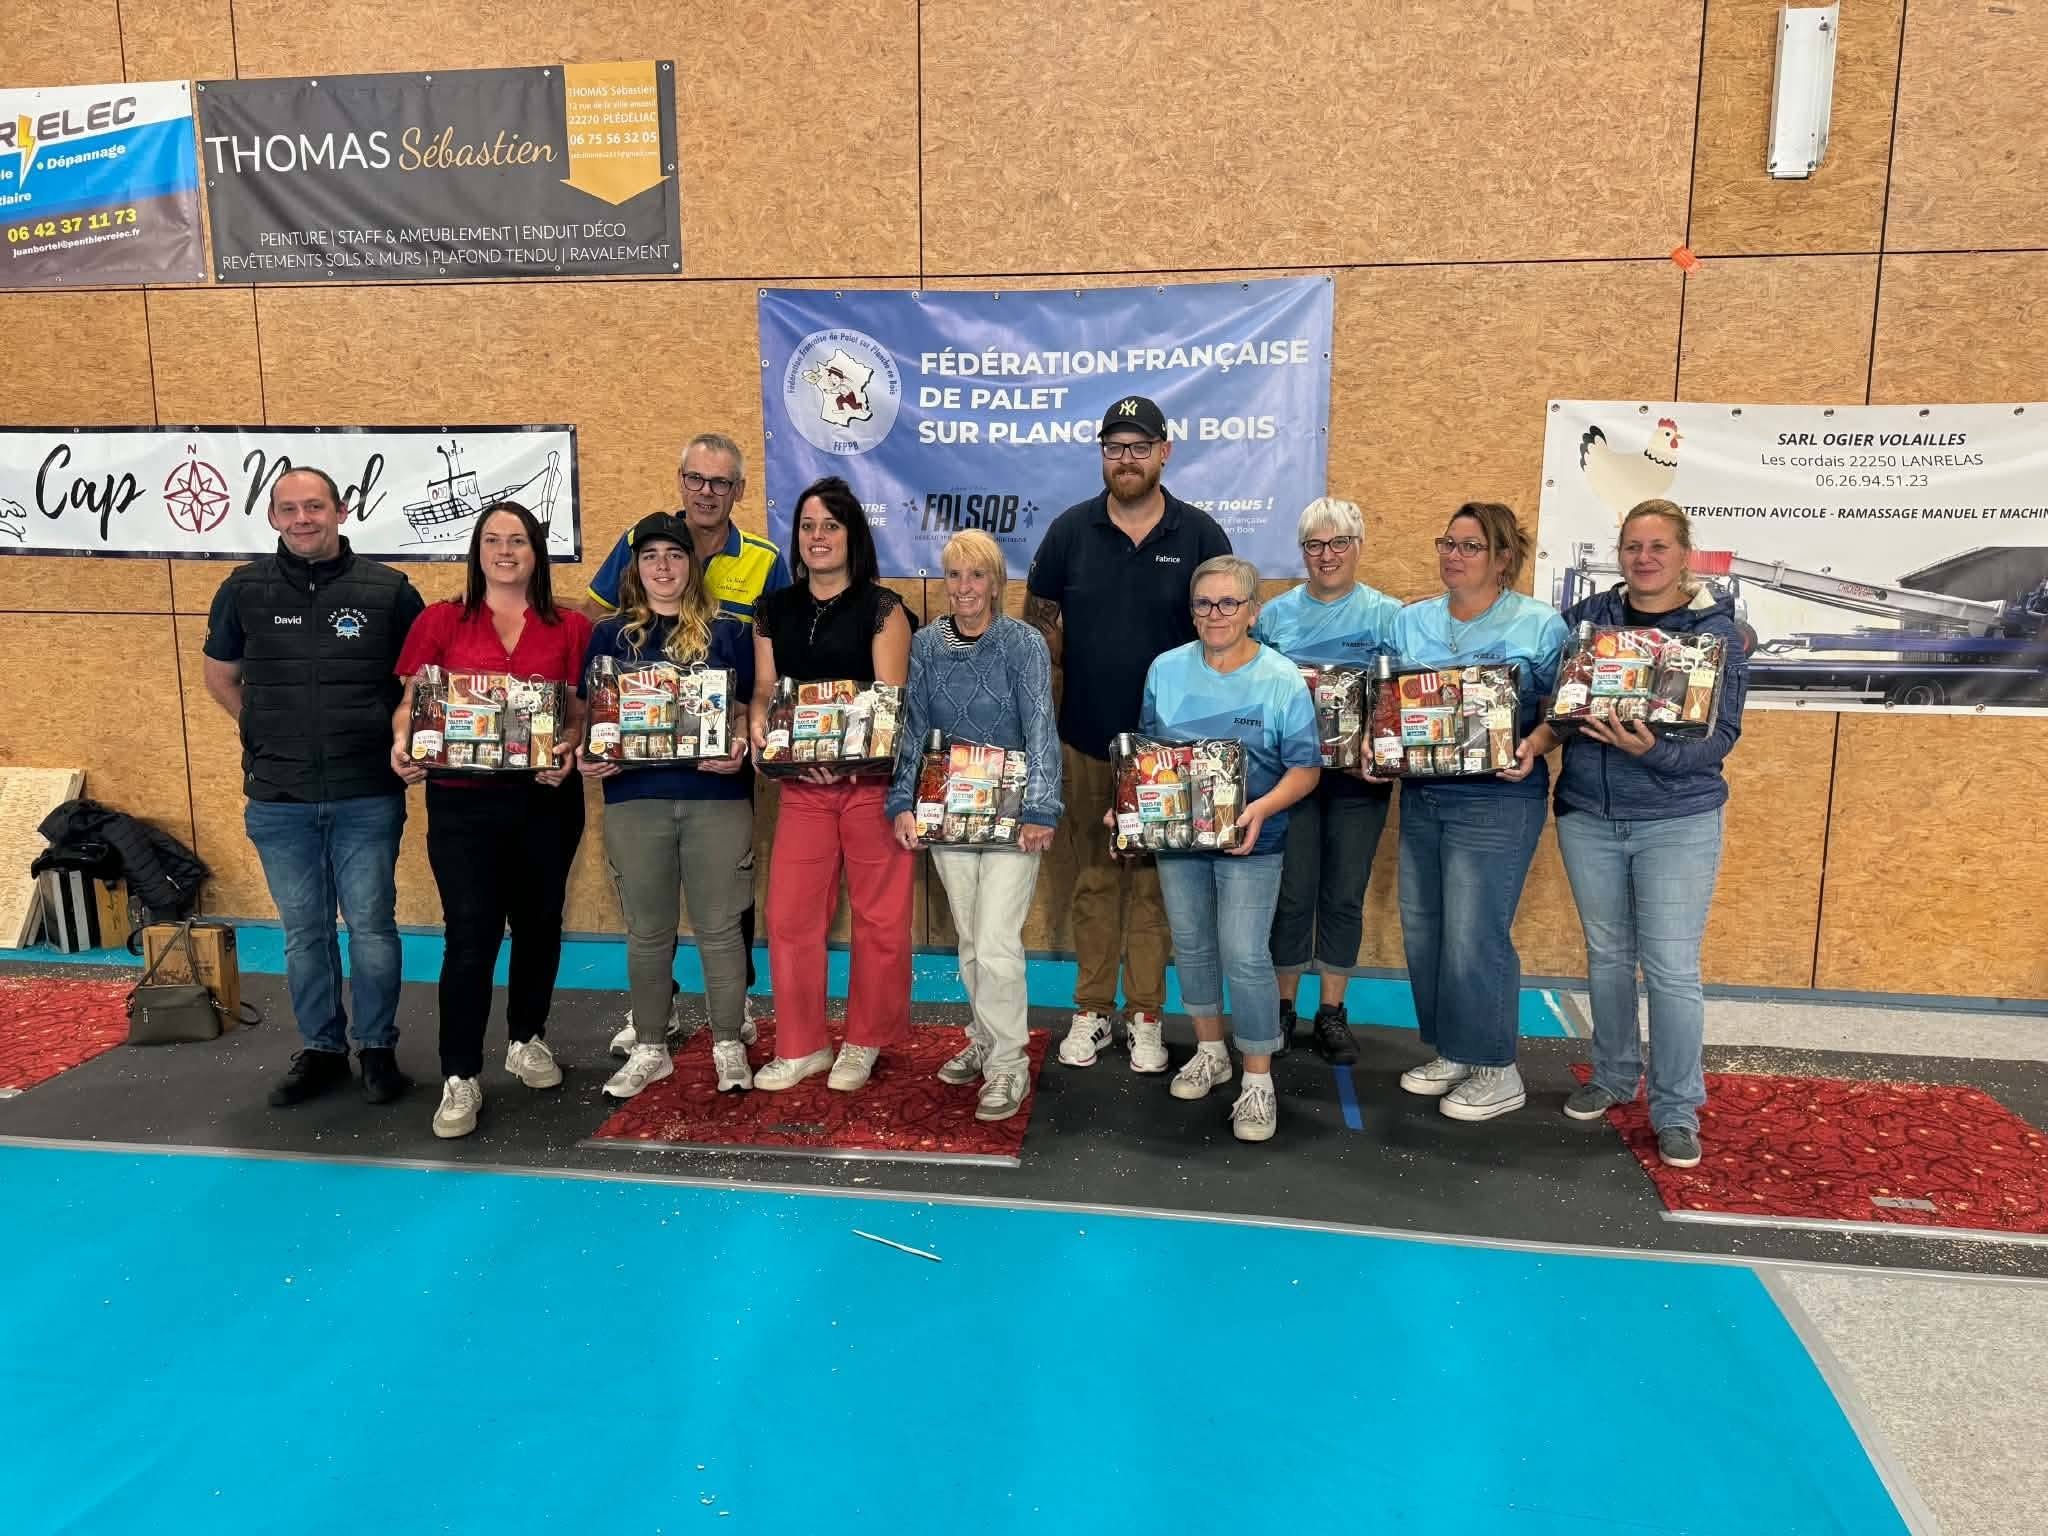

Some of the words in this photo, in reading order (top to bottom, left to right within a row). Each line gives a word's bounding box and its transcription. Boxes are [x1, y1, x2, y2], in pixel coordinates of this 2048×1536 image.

[205, 131, 391, 173] THOMAS
[399, 126, 558, 170] Sébastien
[570, 134, 585, 144] 06
[588, 133, 602, 144] 75
[606, 133, 621, 144] 56
[624, 132, 639, 143] 32
[642, 131, 657, 143] 05
[47, 142, 127, 170] Dépannage
[8, 227, 30, 242] 06
[34, 222, 57, 237] 42
[60, 218, 82, 234] 37
[89, 213, 111, 229] 11
[115, 208, 137, 223] 73
[260, 230, 328, 246] PEINTURE
[338, 229, 384, 245] STAFF
[386, 229, 396, 244] &
[400, 225, 512, 243] AMEUBLEMENT
[523, 222, 579, 240] ENDUIT
[583, 218, 626, 239] DÉCO
[222, 251, 322, 270] REVÊTEMENTS
[326, 252, 360, 267] SOLS
[364, 252, 375, 267] &
[379, 250, 421, 266] MURS
[433, 247, 504, 265] PLAFOND
[506, 246, 557, 263] TENDU
[570, 244, 671, 262] RAVALEMENT
[920, 346, 1118, 376] FÉDÉRATION
[1127, 340, 1310, 374] FRANÇAISE
[919, 386, 961, 410] DE
[971, 387, 1069, 411] PALET
[918, 420, 979, 446] SUR
[989, 420, 1103, 446] PLANC
[1167, 417, 1189, 441] N
[1199, 416, 1276, 441] BOIS
[1777, 432, 1818, 447] SARL
[1822, 433, 1874, 447] OGIER
[1879, 432, 1967, 447] VOLAILLES
[187, 443, 197, 455] N
[1761, 453, 1786, 466] Les
[1790, 453, 1845, 468] cordais
[1849, 455, 1897, 468] 22250
[1901, 453, 1985, 468] LANRELAS
[35, 443, 147, 541] Cap
[243, 449, 387, 522] Nd
[1815, 474, 1929, 488] 06.26.94.51.23
[921, 493, 1020, 534] FALSAB
[1217, 499, 1263, 511] nous
[1680, 506, 1766, 518] TERVENTION
[1770, 507, 1827, 519] AVICOLE
[1838, 507, 1919, 519] RAMASSAGE
[1922, 508, 1978, 519] MANUEL
[1982, 508, 1998, 519] ET
[1155, 554, 1181, 564] Fabrice
[274, 615, 302, 625] David
